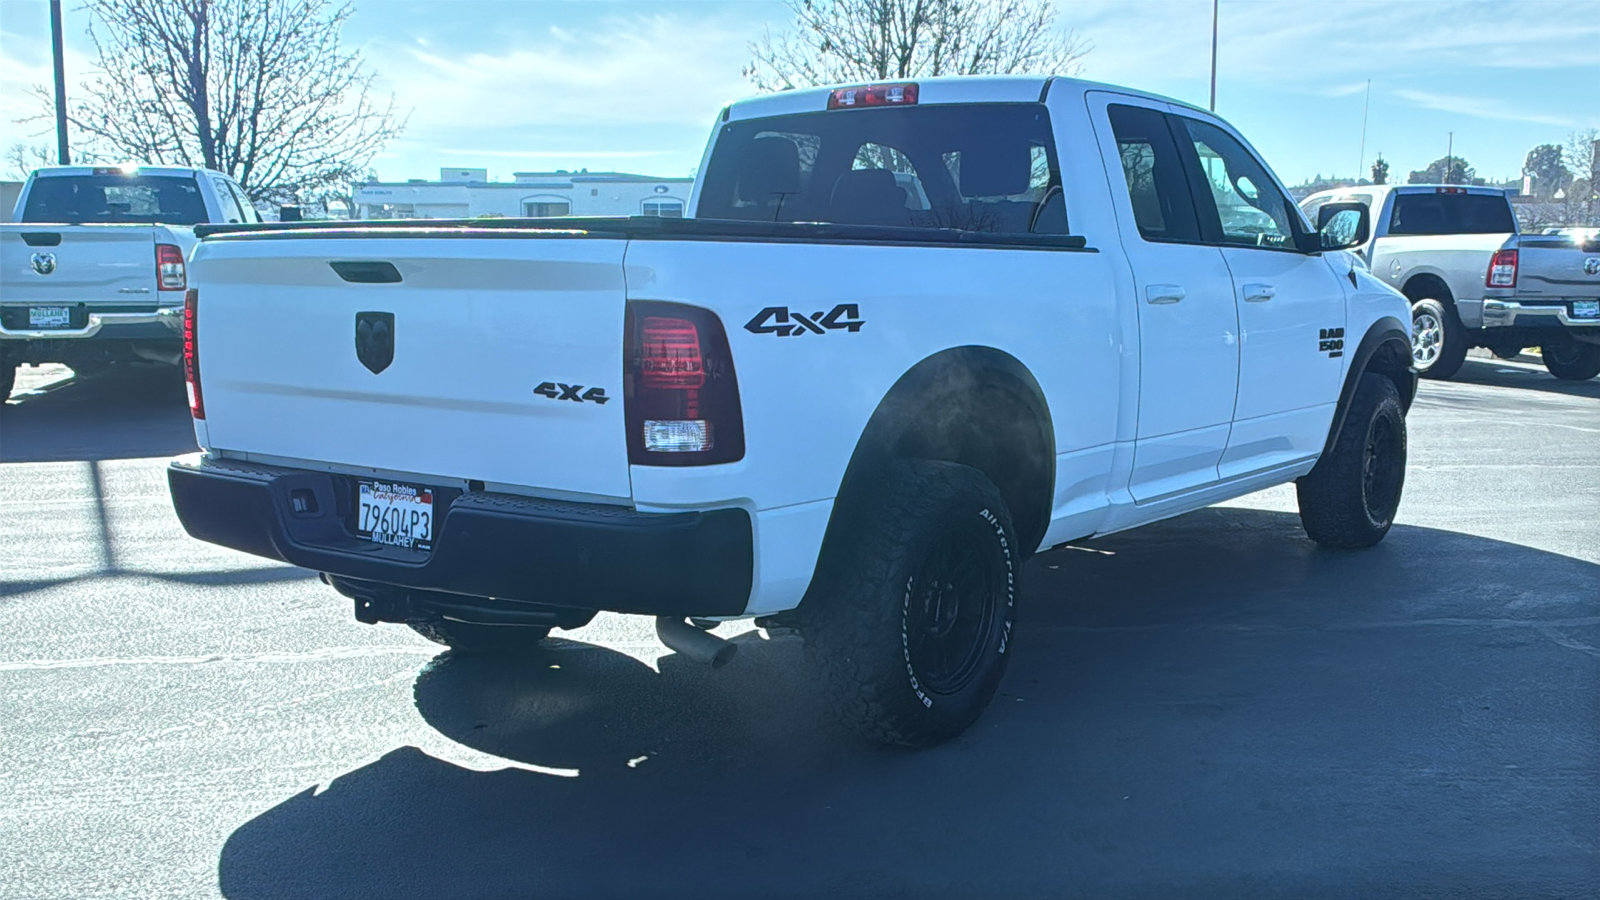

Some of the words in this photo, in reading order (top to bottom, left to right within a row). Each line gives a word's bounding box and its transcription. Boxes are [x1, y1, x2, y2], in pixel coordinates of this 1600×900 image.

[1319, 327, 1345, 340] RAM
[1319, 339, 1344, 352] 1500
[374, 481, 391, 492] Paso
[392, 484, 417, 495] Robles
[362, 503, 430, 538] 79604P3
[372, 531, 416, 549] MULLAHEY
[979, 508, 1015, 608] All-Terrain
